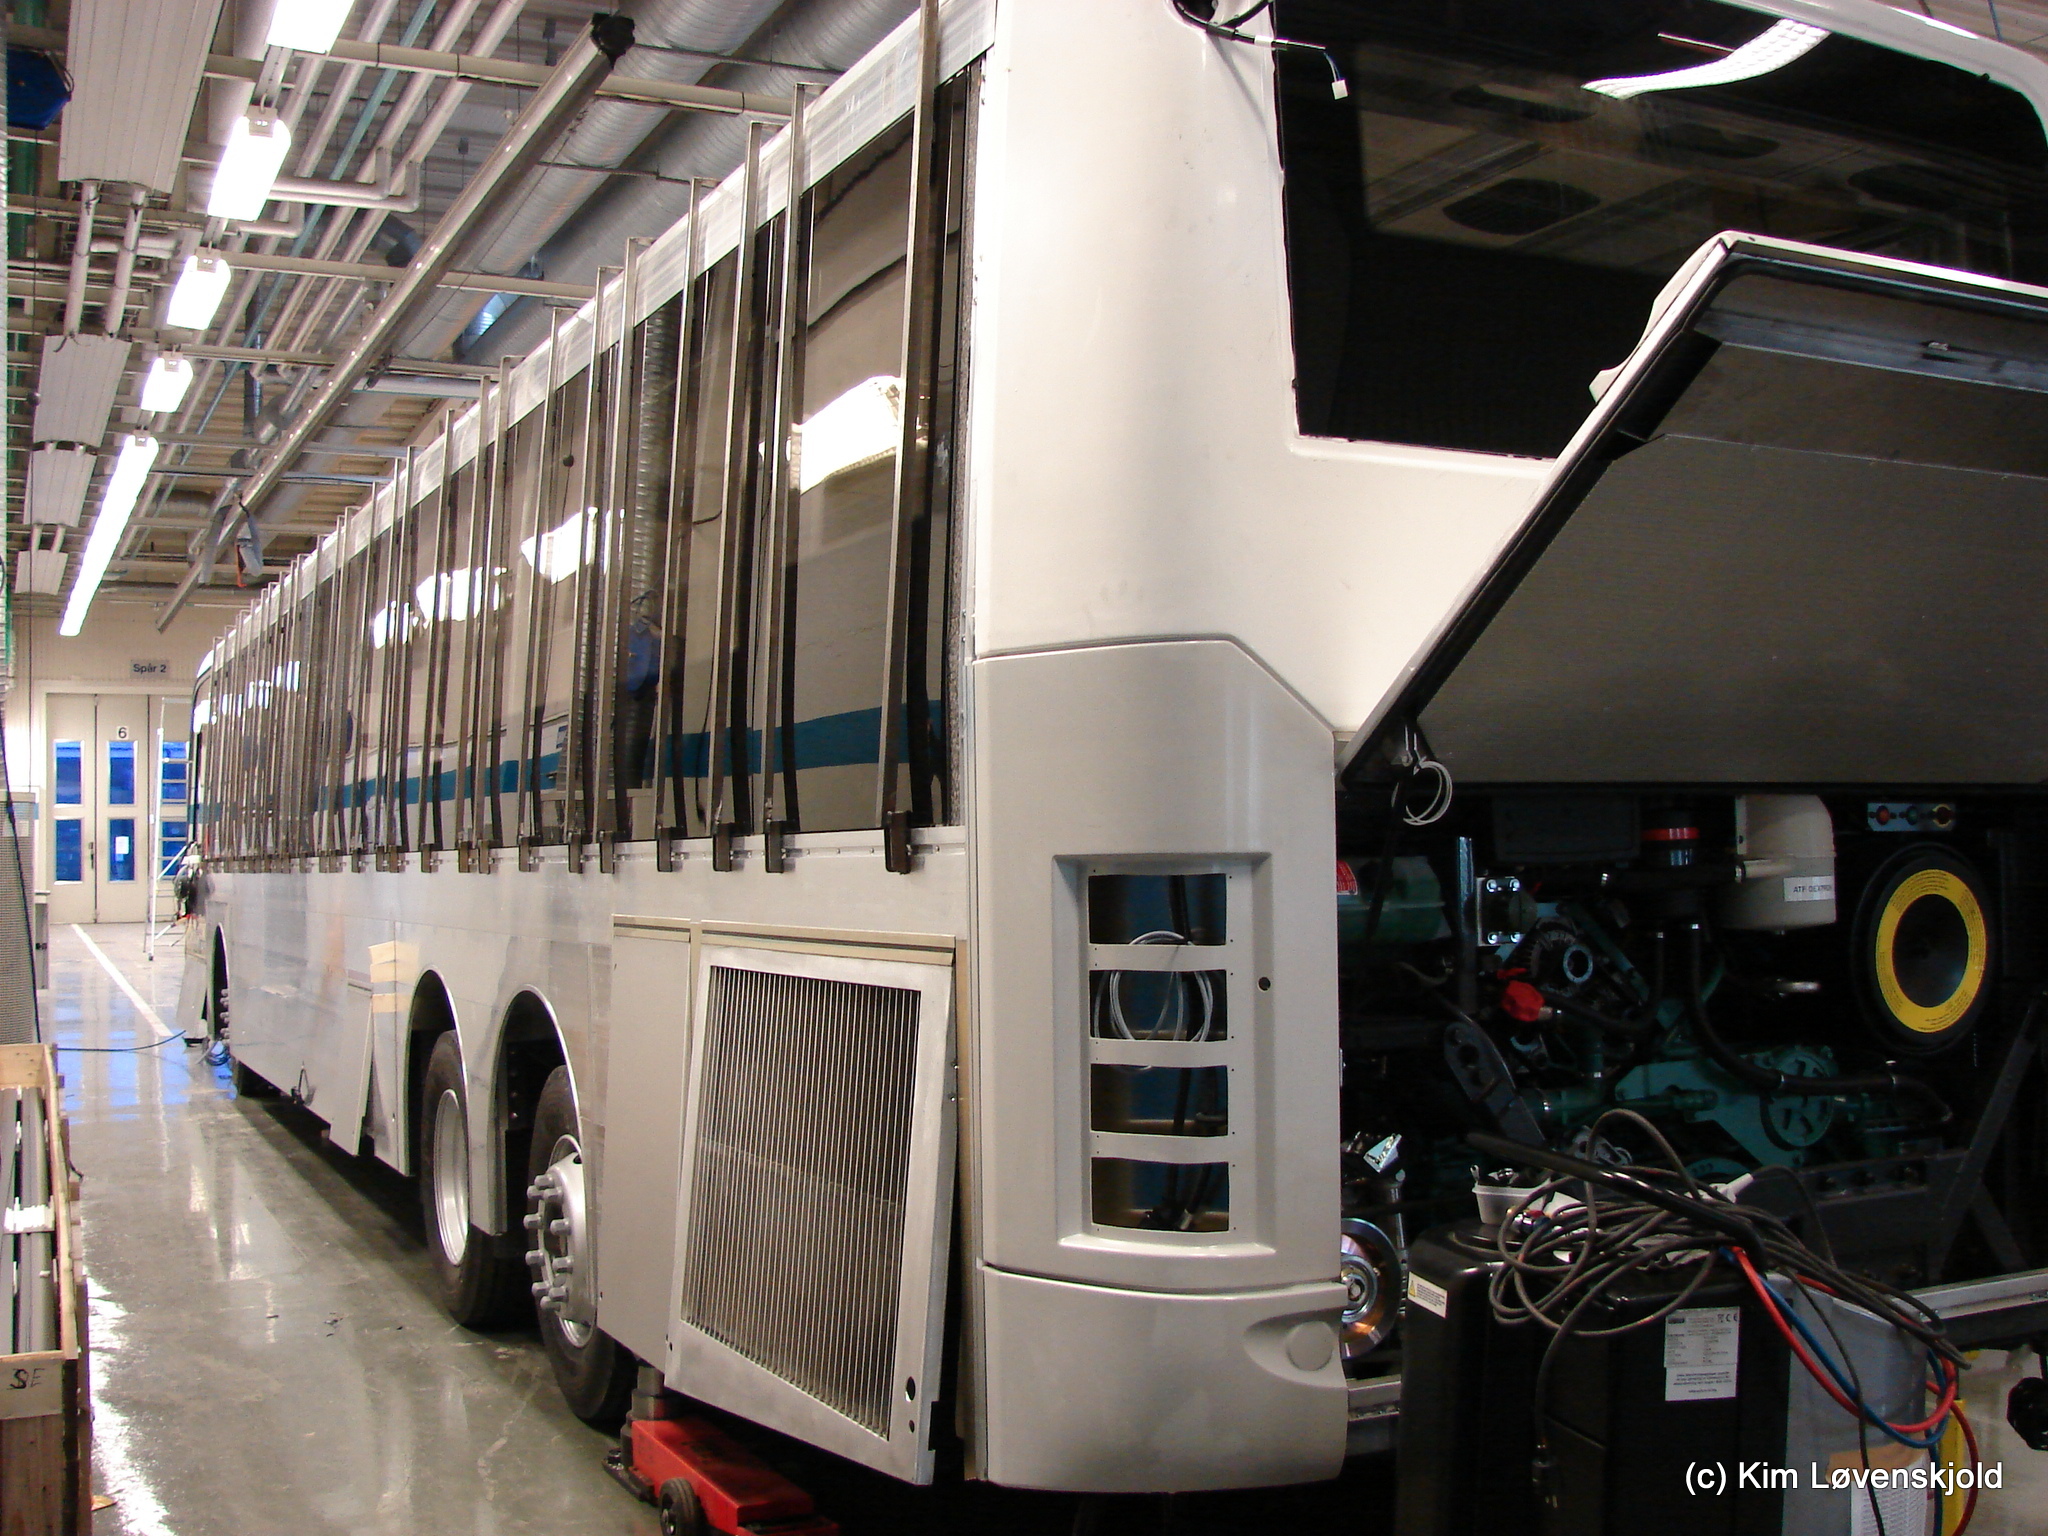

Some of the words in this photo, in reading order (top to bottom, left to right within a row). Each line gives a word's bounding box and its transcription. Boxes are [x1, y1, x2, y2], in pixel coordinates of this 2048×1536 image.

[133, 662, 157, 675] Spår
[160, 664, 167, 673] 2
[118, 727, 127, 739] 6
